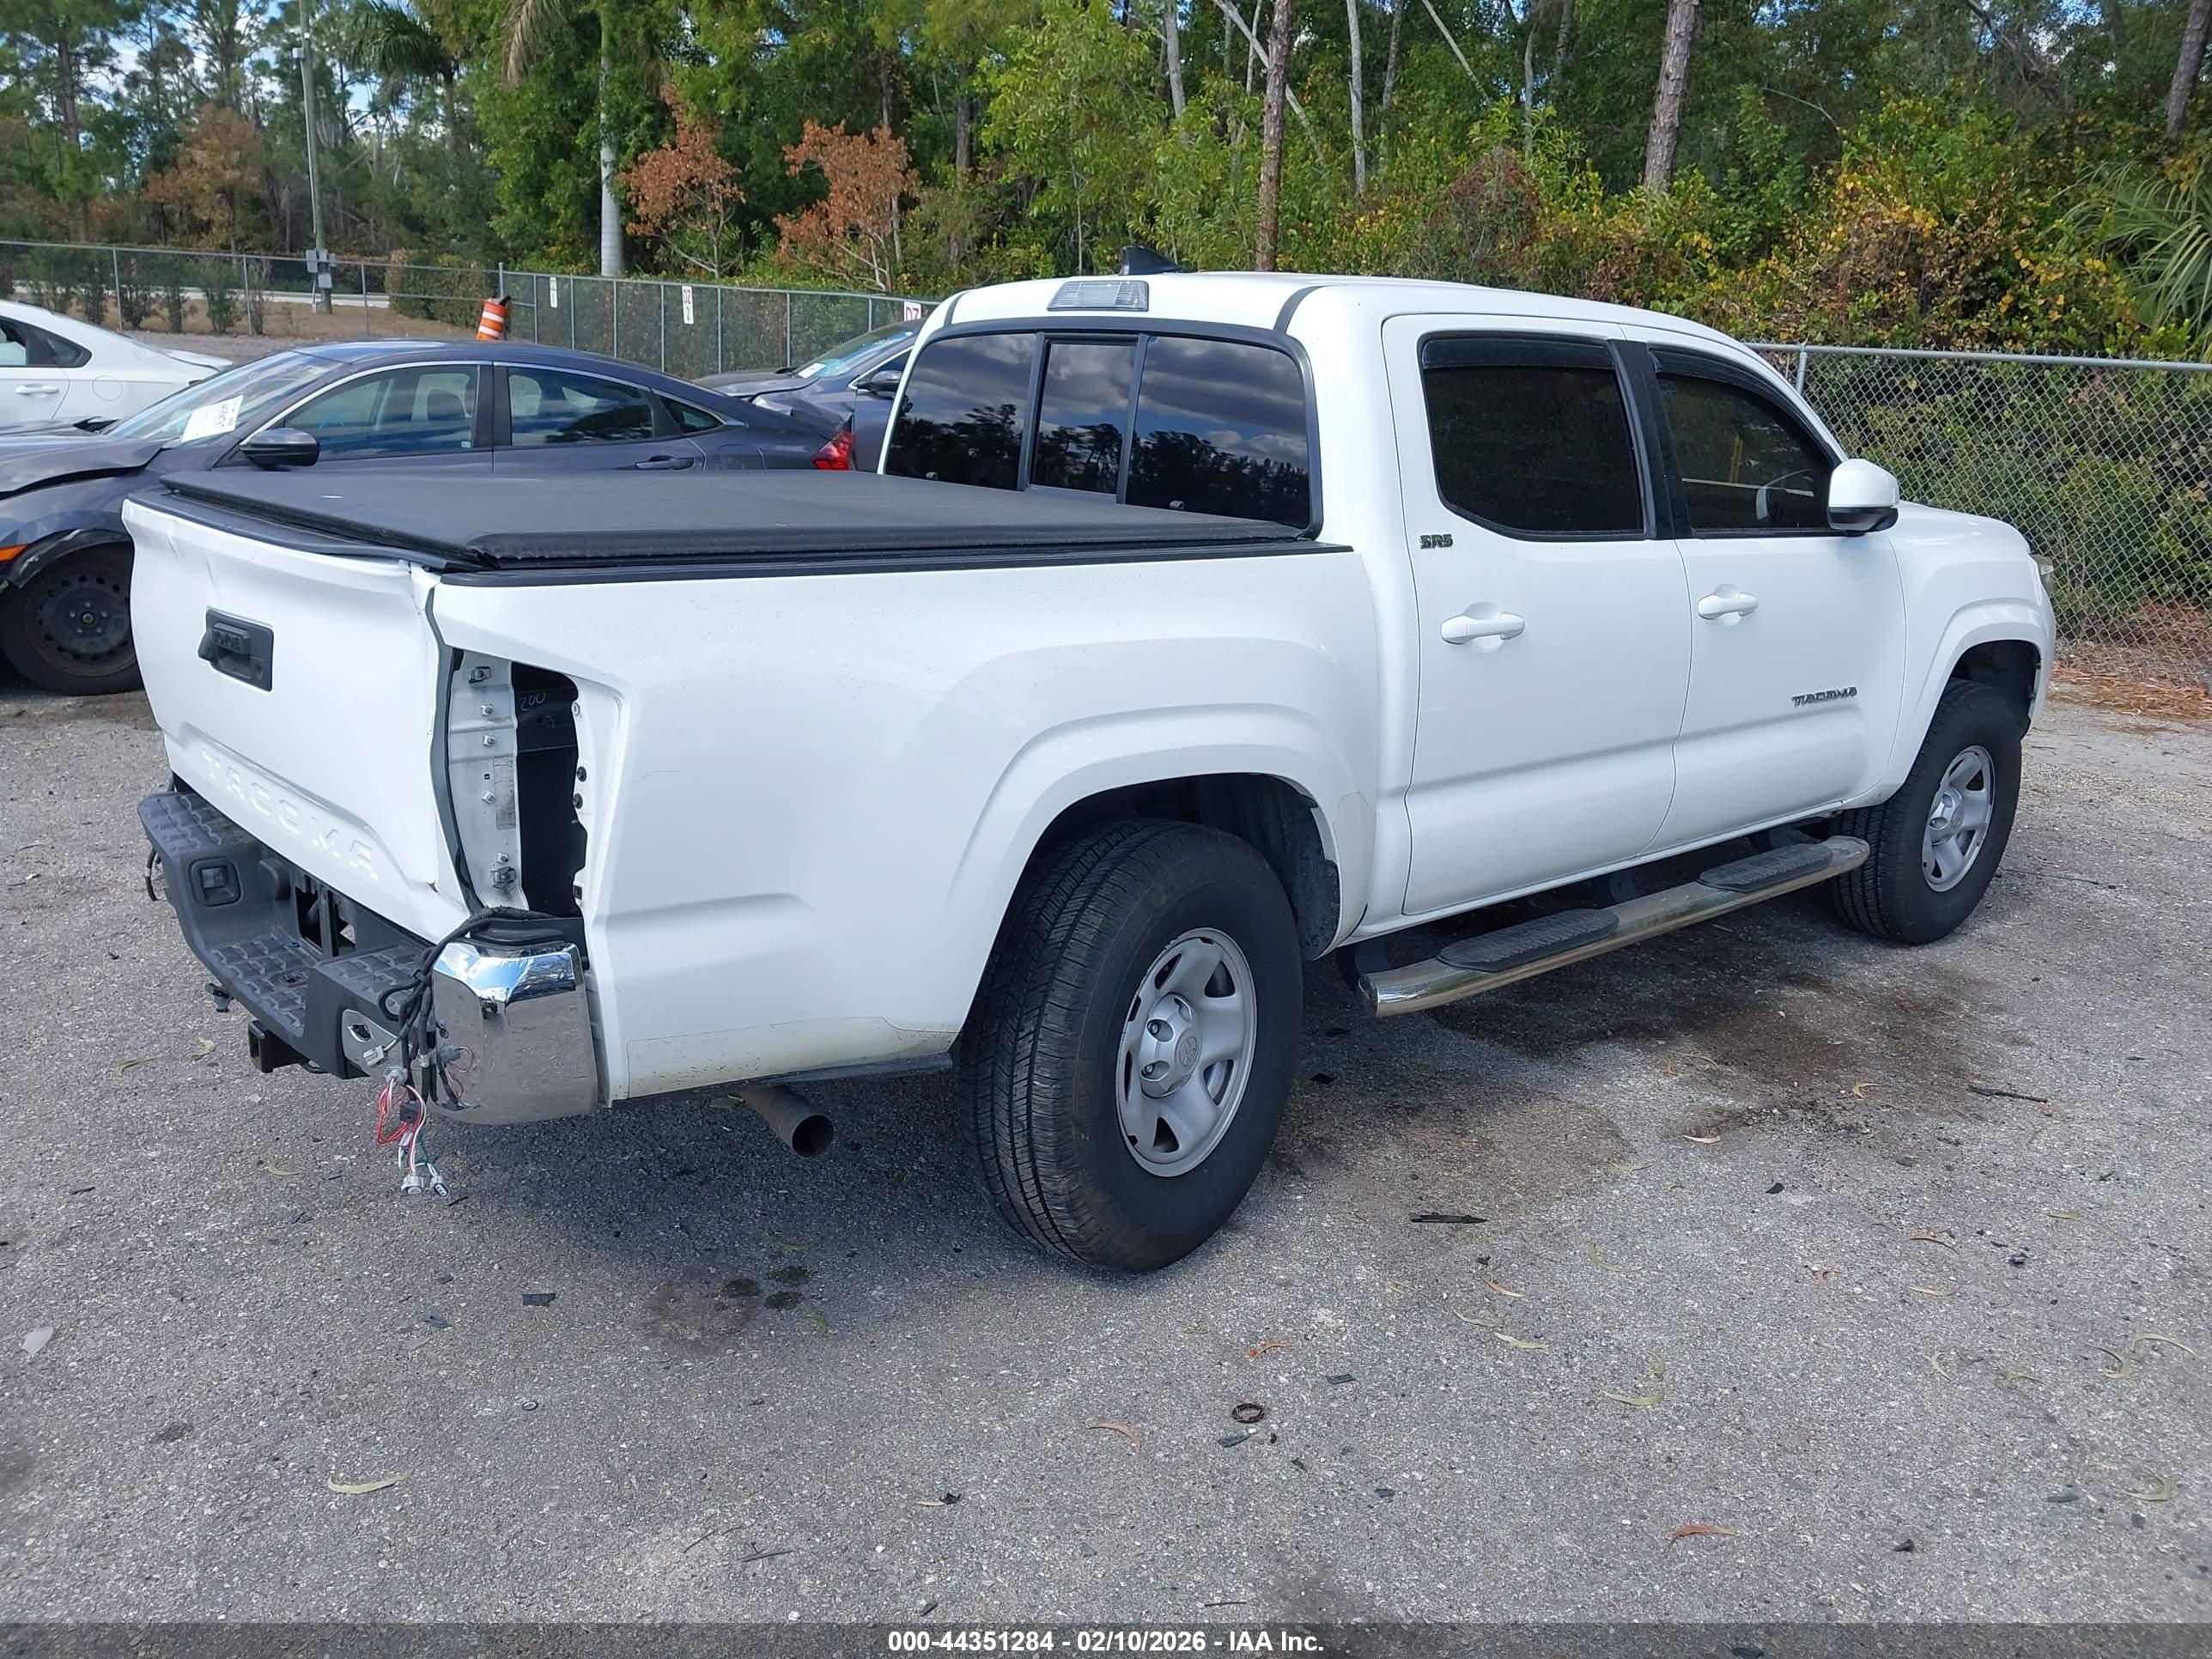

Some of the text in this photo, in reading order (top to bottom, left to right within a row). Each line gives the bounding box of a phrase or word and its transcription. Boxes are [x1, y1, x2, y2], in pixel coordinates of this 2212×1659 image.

[1419, 533, 1454, 550] SR5
[1791, 686, 1857, 708] TACOMA
[201, 749, 379, 880] TACOMA
